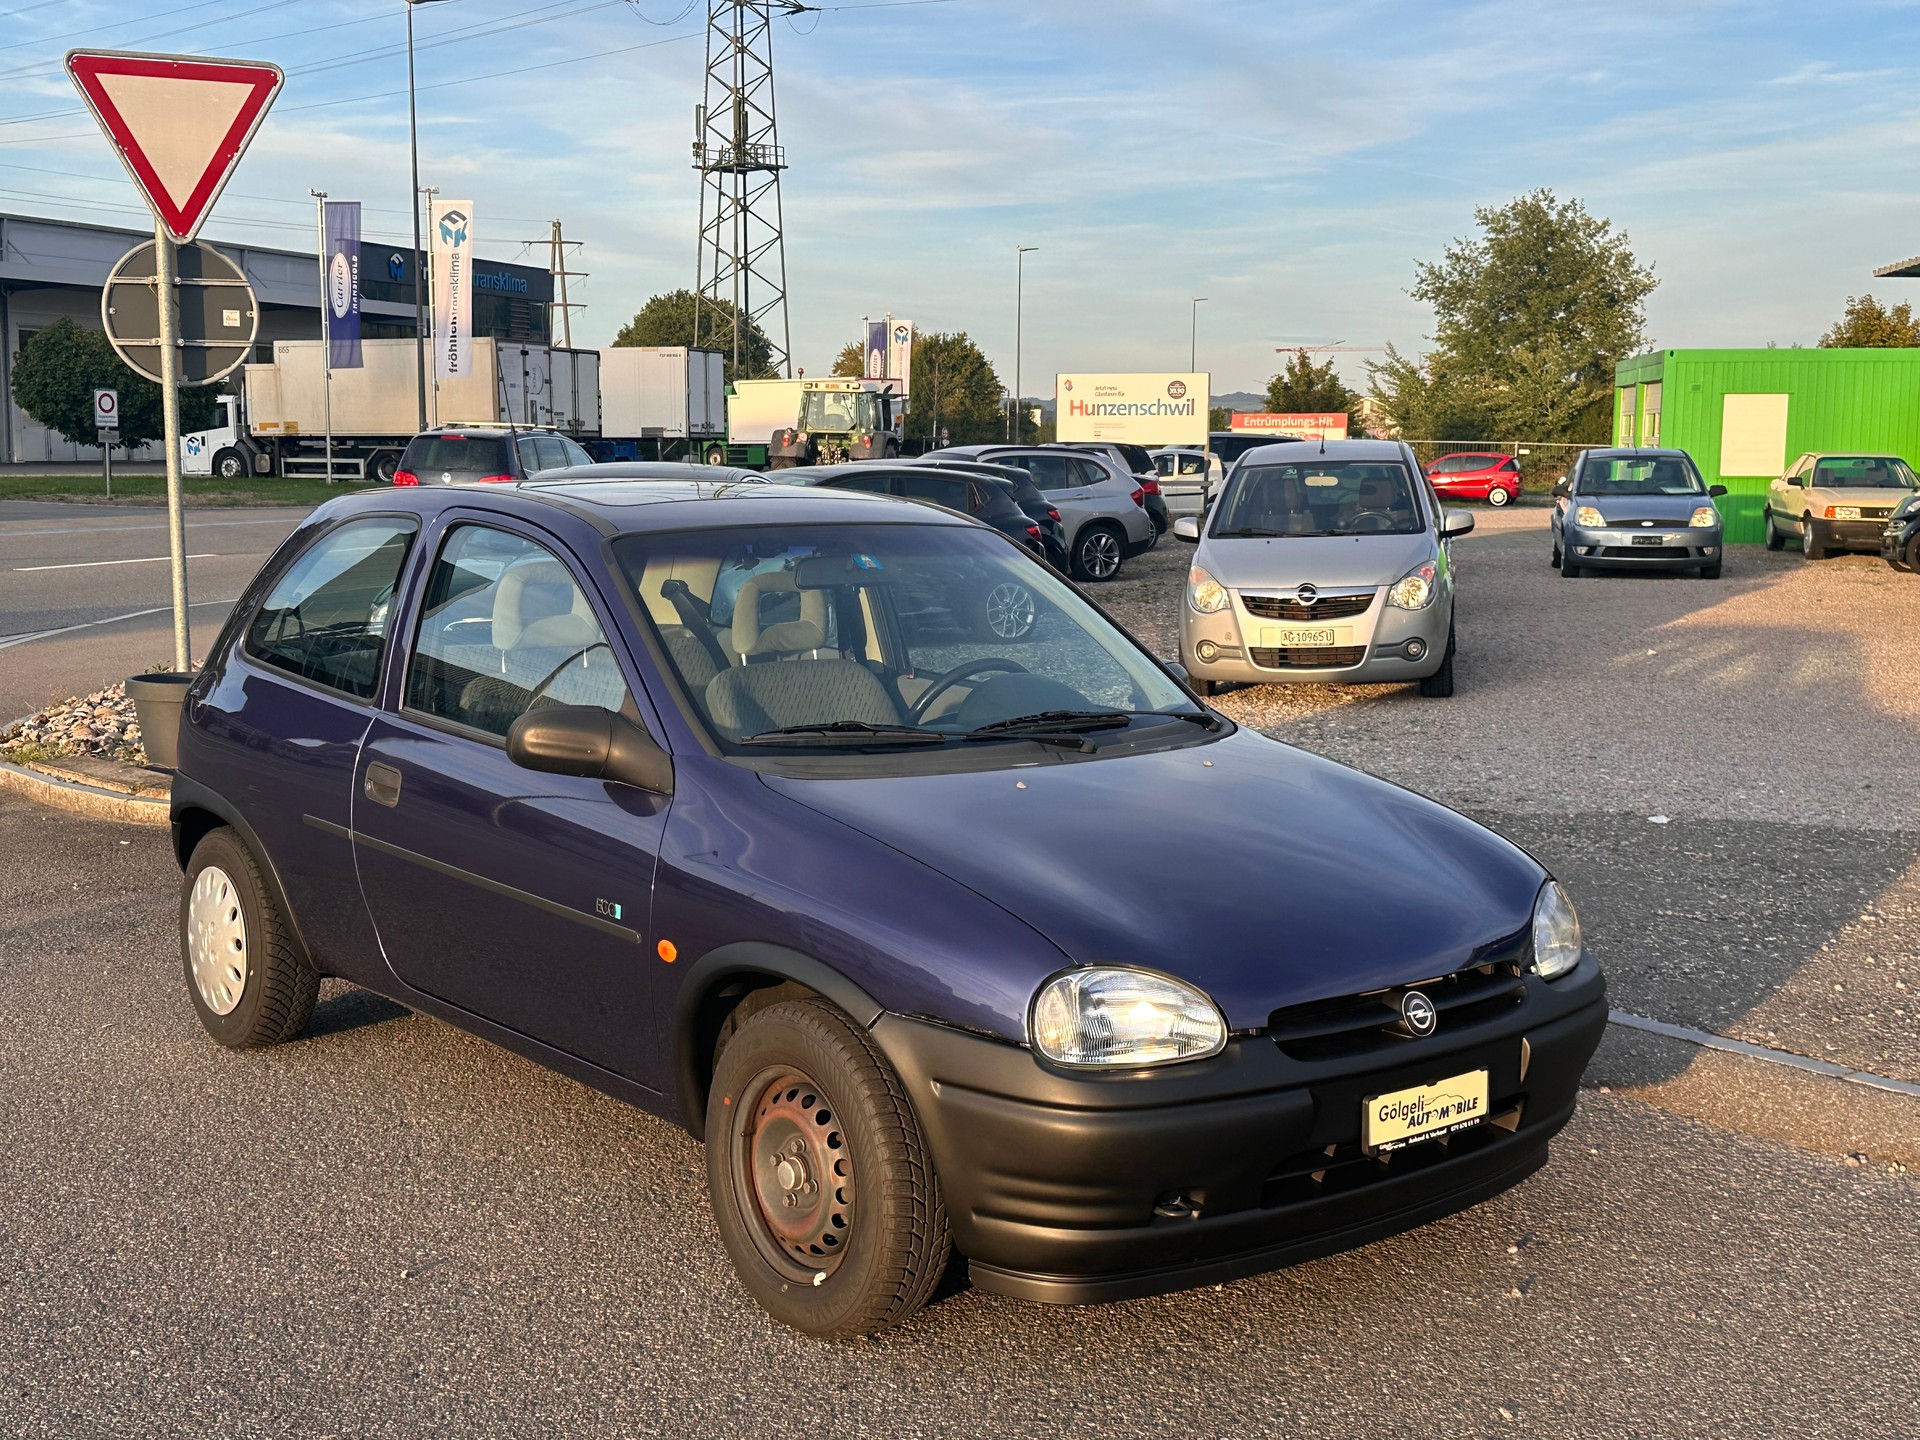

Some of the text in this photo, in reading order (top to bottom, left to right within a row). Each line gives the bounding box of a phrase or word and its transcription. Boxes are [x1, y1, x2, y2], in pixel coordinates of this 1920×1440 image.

[335, 261, 344, 308] Carrier
[1069, 398, 1195, 416] Hunzenschwil
[1243, 416, 1334, 428] Entrümplungs-Hit
[596, 897, 615, 918] ECO
[1379, 1094, 1425, 1122] Gölgeli
